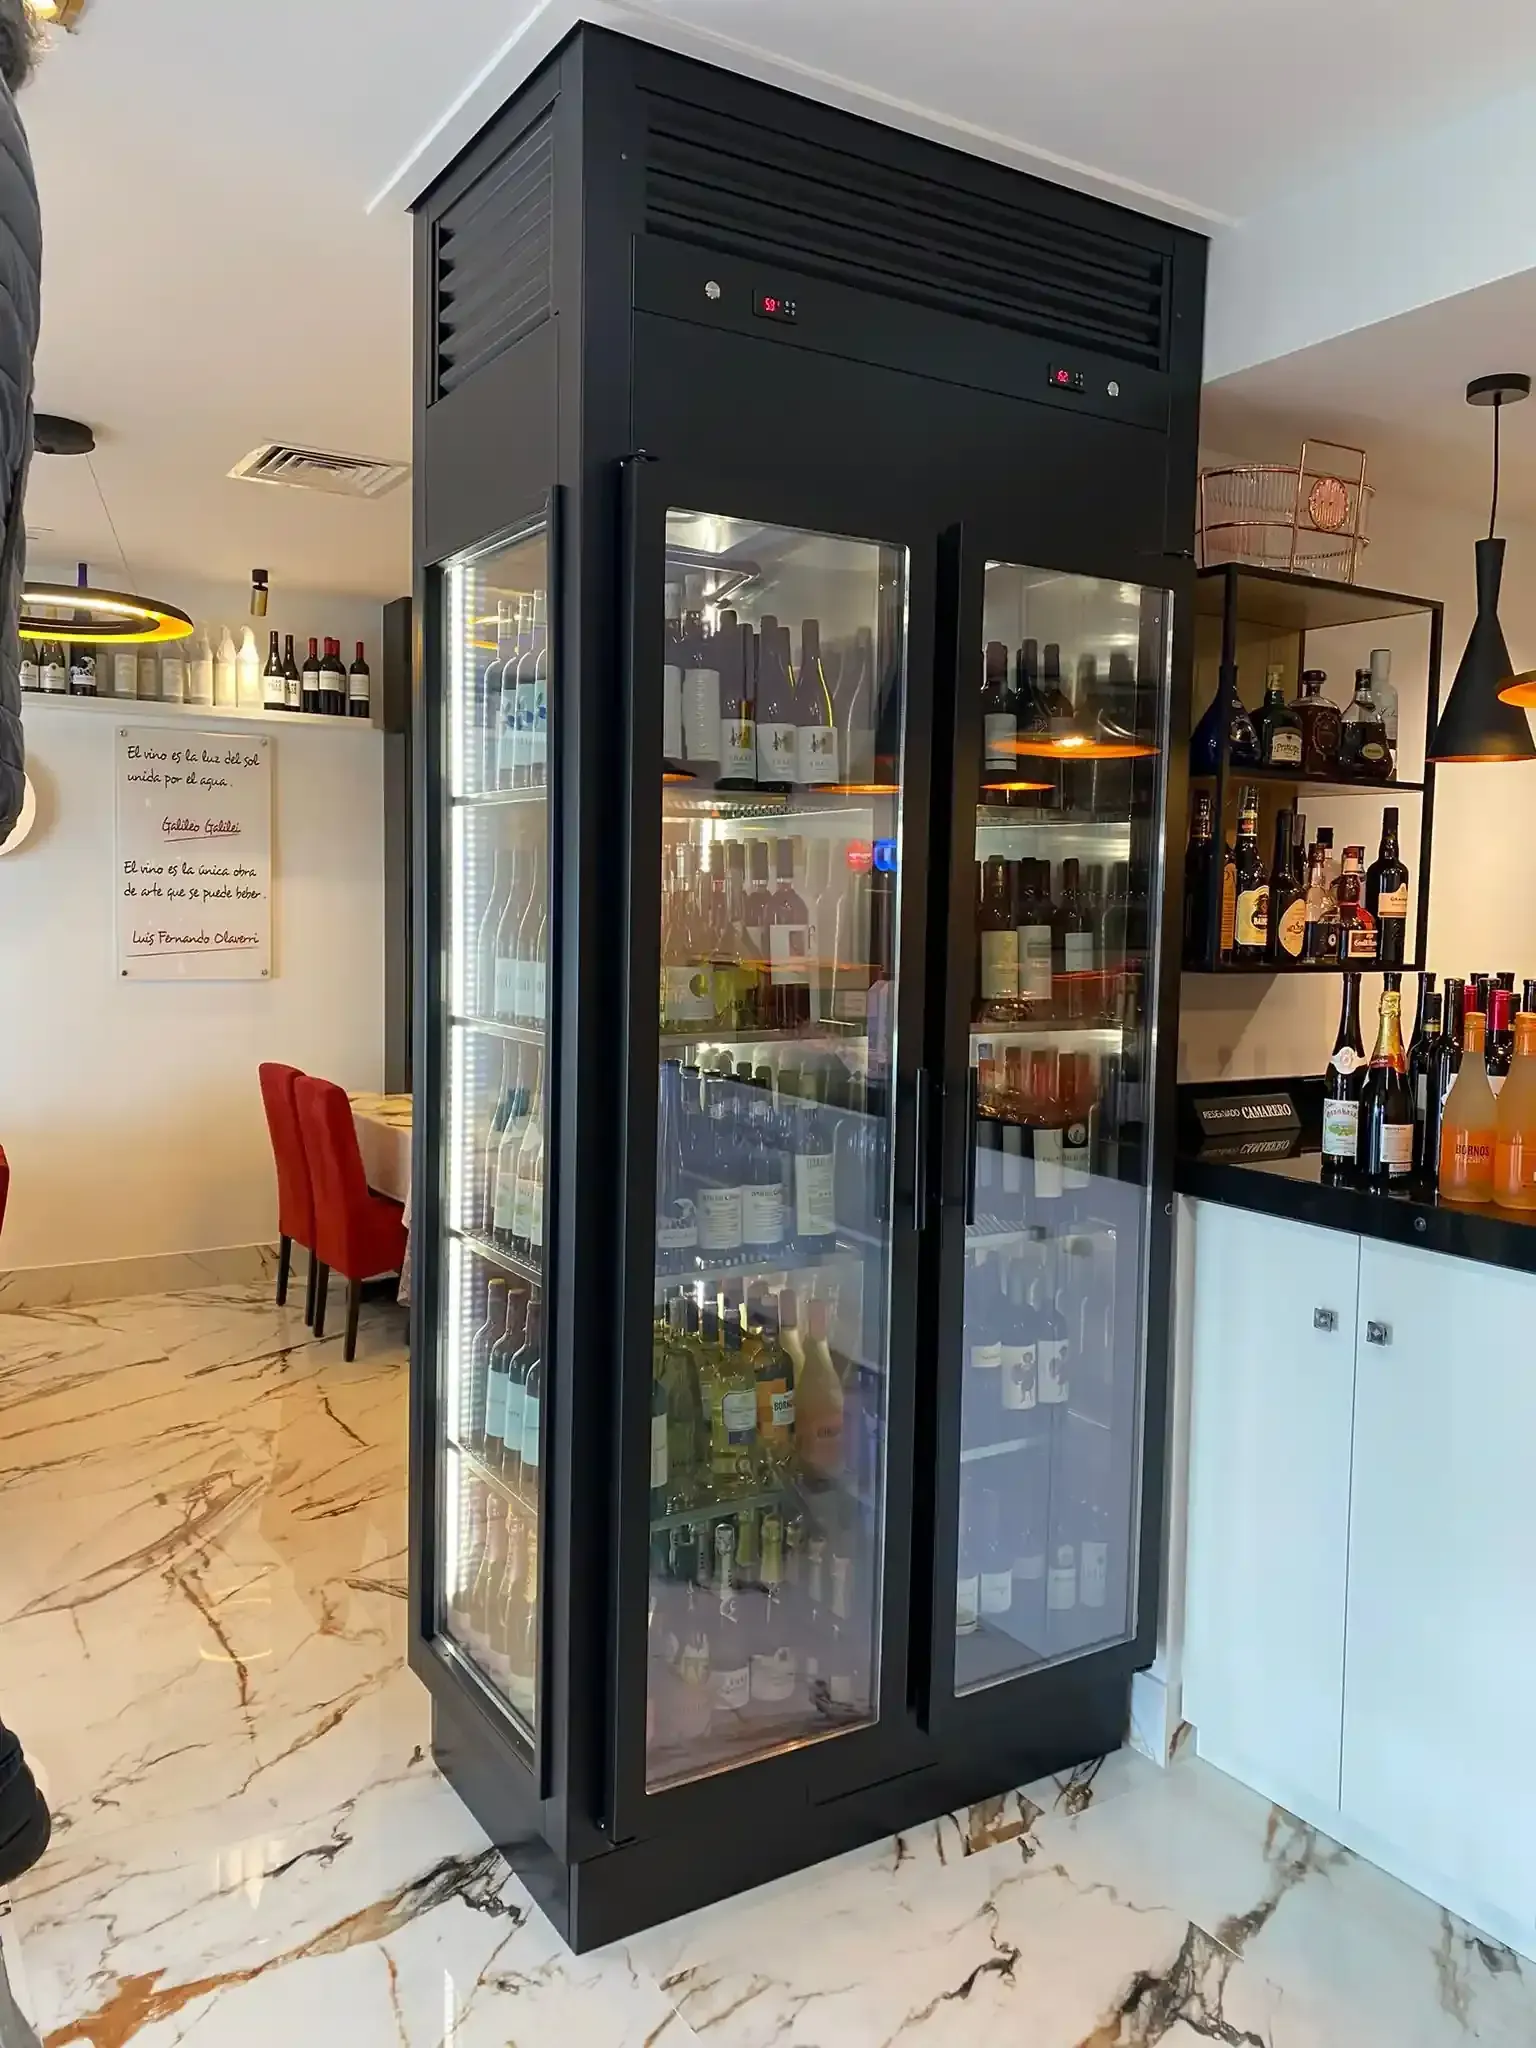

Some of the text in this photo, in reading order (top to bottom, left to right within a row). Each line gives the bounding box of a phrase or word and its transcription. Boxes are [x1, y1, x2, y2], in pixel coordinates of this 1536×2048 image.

[128, 745, 260, 767] El vino es la luz del sol
[127, 768, 161, 782] unida
[164, 774, 182, 789] por
[186, 772, 197, 784] el
[161, 816, 241, 834] Galileo Galilei
[124, 861, 256, 878] El vino es la única obra
[124, 882, 137, 896] de
[140, 882, 163, 897] arte
[167, 888, 186, 901] que
[189, 888, 199, 900] se
[203, 884, 232, 903] puede
[132, 929, 260, 946] Luis Fernando Olaverri
[1241, 1104, 1292, 1119] CAMARERO
[1456, 1145, 1490, 1156] BORNOS
